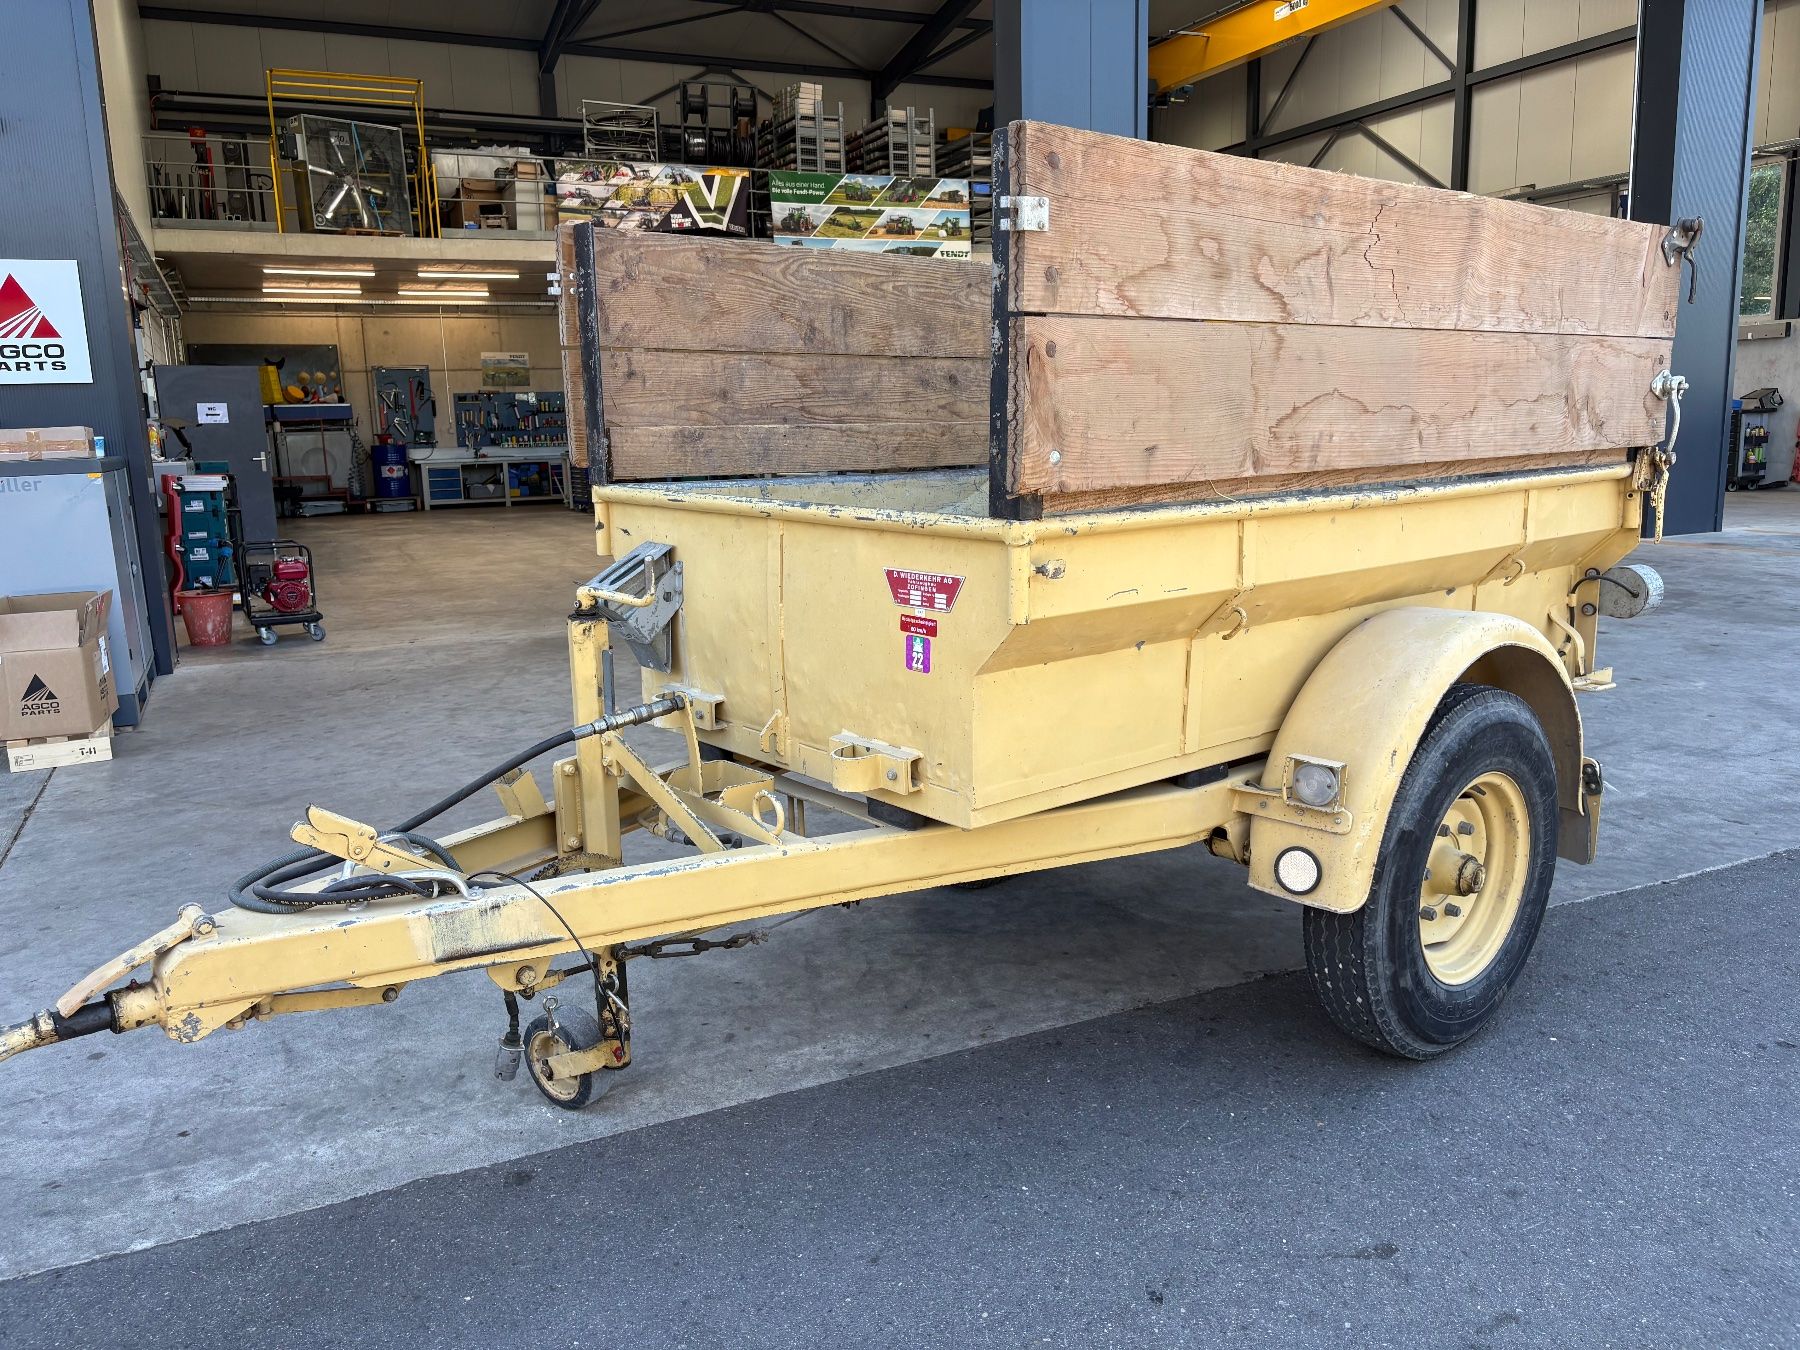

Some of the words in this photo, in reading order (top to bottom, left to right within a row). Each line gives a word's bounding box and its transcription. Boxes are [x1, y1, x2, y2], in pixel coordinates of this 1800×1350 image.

[771, 179, 784, 187] Alles
[940, 250, 970, 258] FENDT
[0, 344, 65, 359] GCO
[0, 361, 67, 372] ARTS
[0, 477, 42, 493] üller
[899, 571, 942, 583] WIEDERKEHR
[943, 577, 953, 585] AG
[907, 584, 937, 593] ZOFINGEN
[912, 651, 924, 669] 22
[21, 701, 60, 711] AGCO
[21, 709, 61, 717] PARTS
